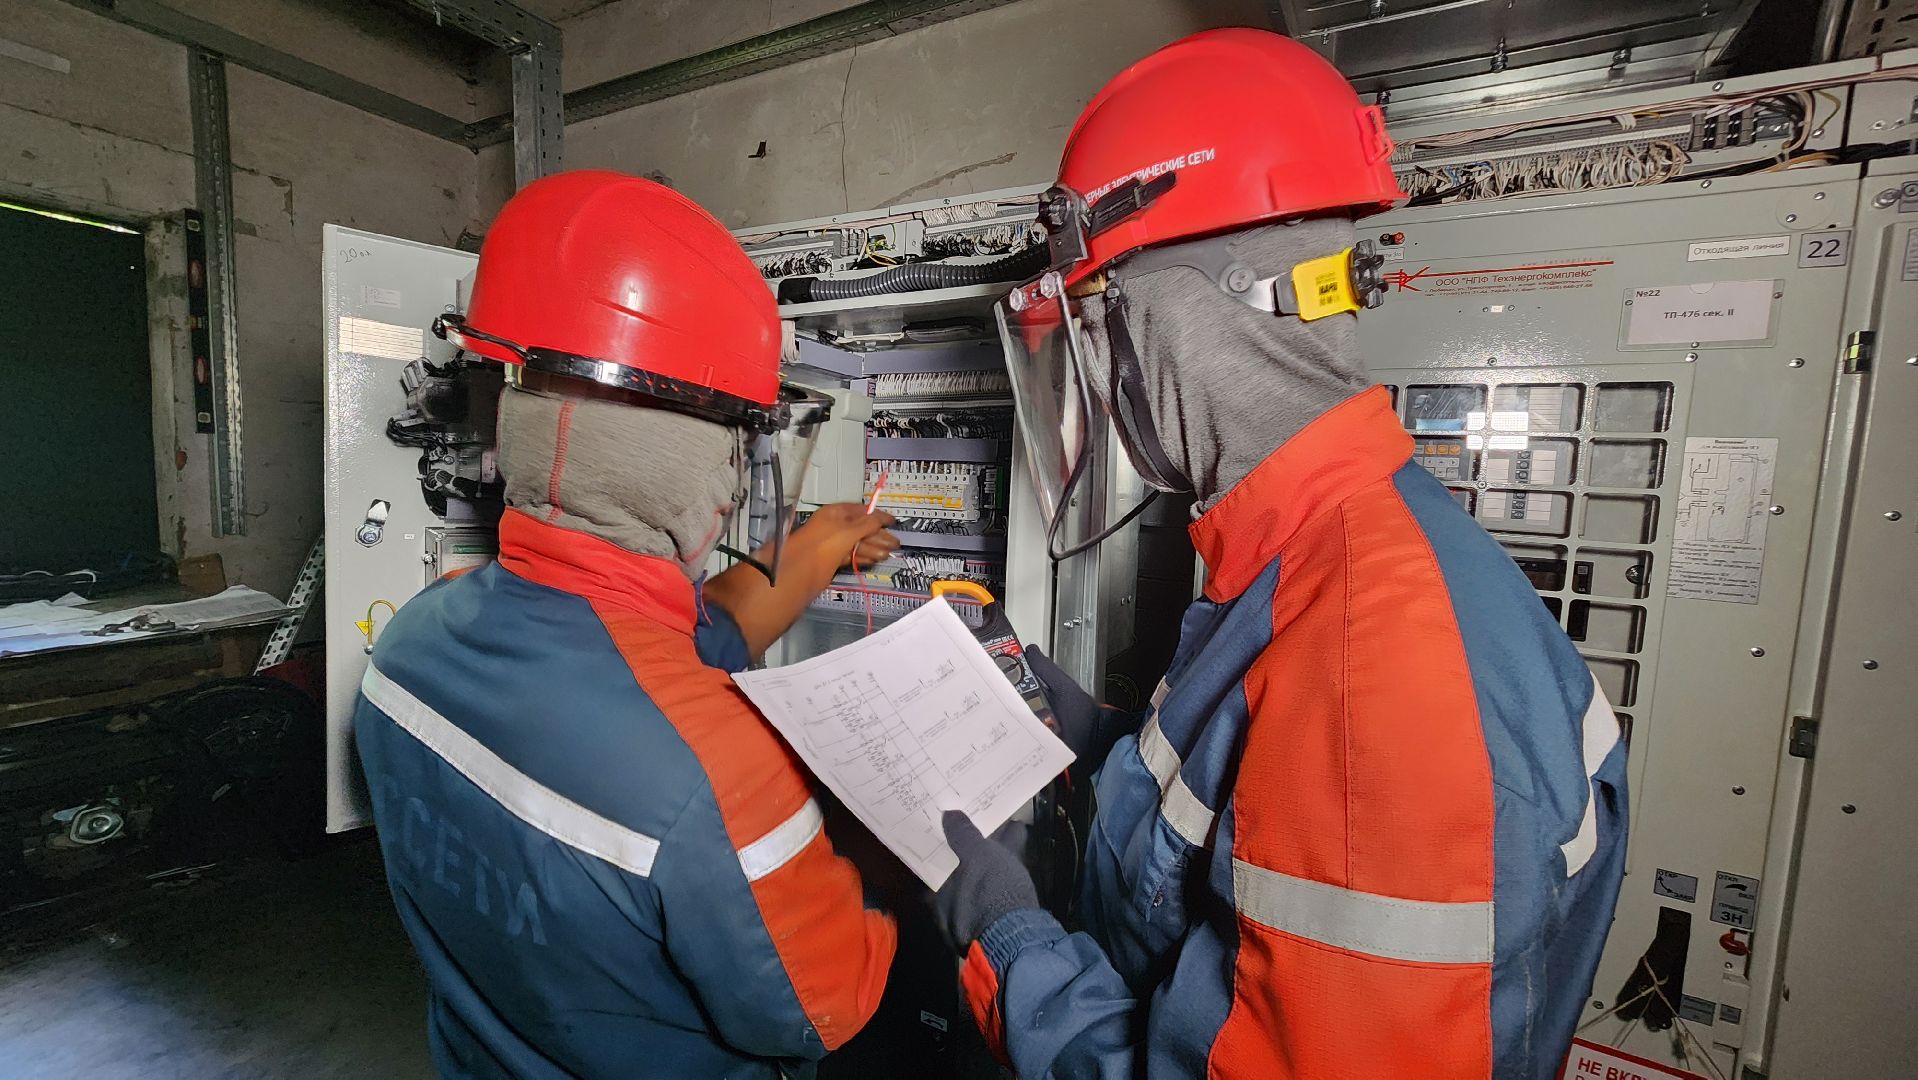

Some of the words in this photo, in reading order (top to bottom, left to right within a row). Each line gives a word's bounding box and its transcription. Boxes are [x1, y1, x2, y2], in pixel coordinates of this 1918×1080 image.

[1187, 148, 1216, 166] СЕТИ
[1693, 245, 1750, 256] Отходящая
[1752, 242, 1785, 251] линия
[1807, 239, 1841, 259] 22
[1435, 277, 1460, 287] ООО
[1461, 276, 1489, 285] "НПФ
[1492, 268, 1597, 282] Техэнергокомплекс"
[1636, 289, 1661, 298] №22
[1663, 310, 1700, 319] ТП-476
[1702, 309, 1724, 317] сек.
[1578, 1057, 1603, 1077] НЕ
